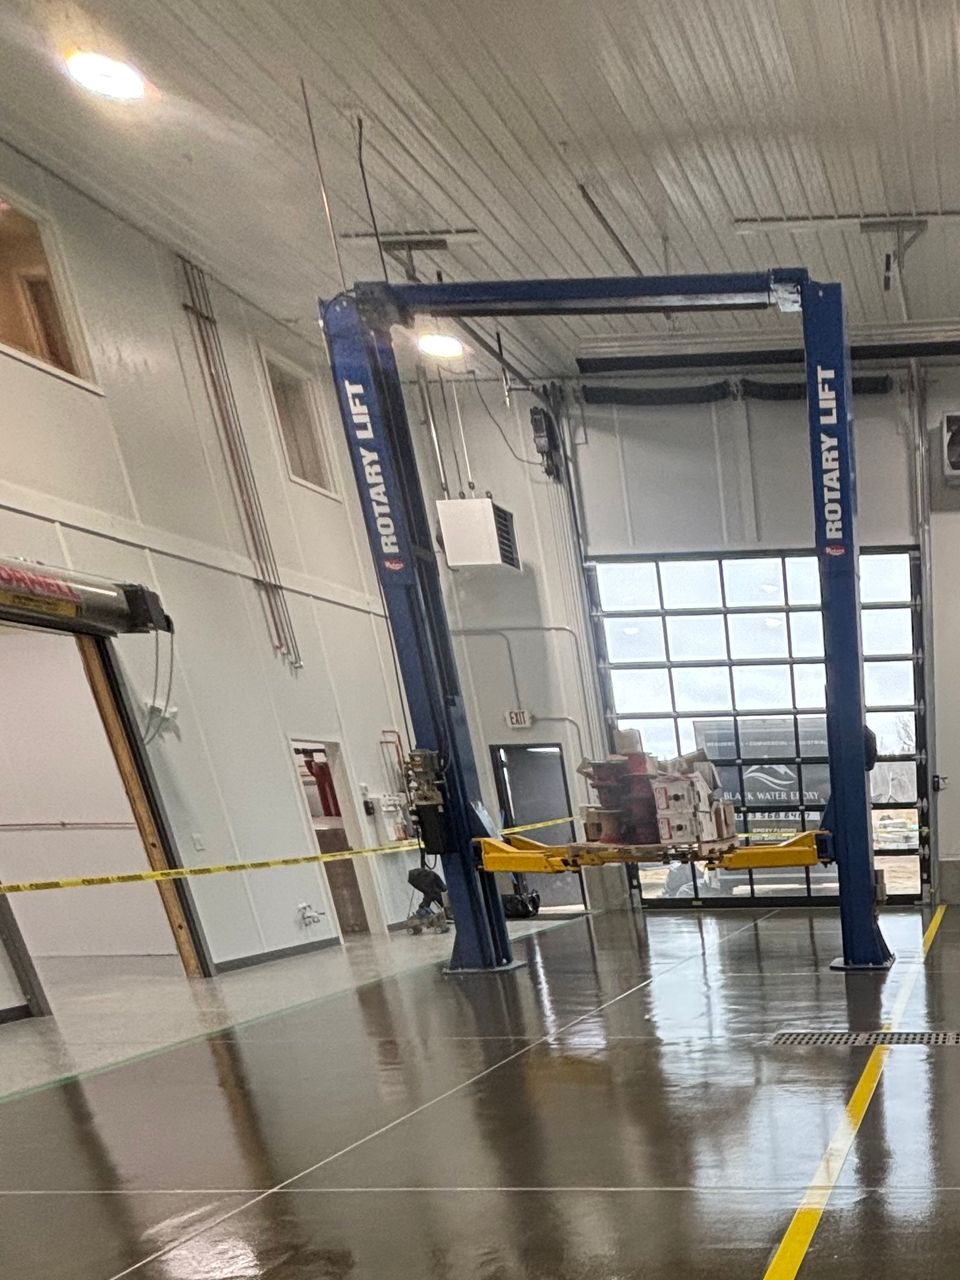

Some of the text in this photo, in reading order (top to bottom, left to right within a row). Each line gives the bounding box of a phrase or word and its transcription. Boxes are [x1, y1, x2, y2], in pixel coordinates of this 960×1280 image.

[344, 379, 374, 439] LIFT
[817, 365, 837, 424] LIFT
[360, 447, 399, 553] ROTARY
[820, 433, 843, 539] ROTARY
[509, 711, 526, 725] EXIT
[723, 791, 753, 800] BLAK
[757, 791, 787, 800] WATER
